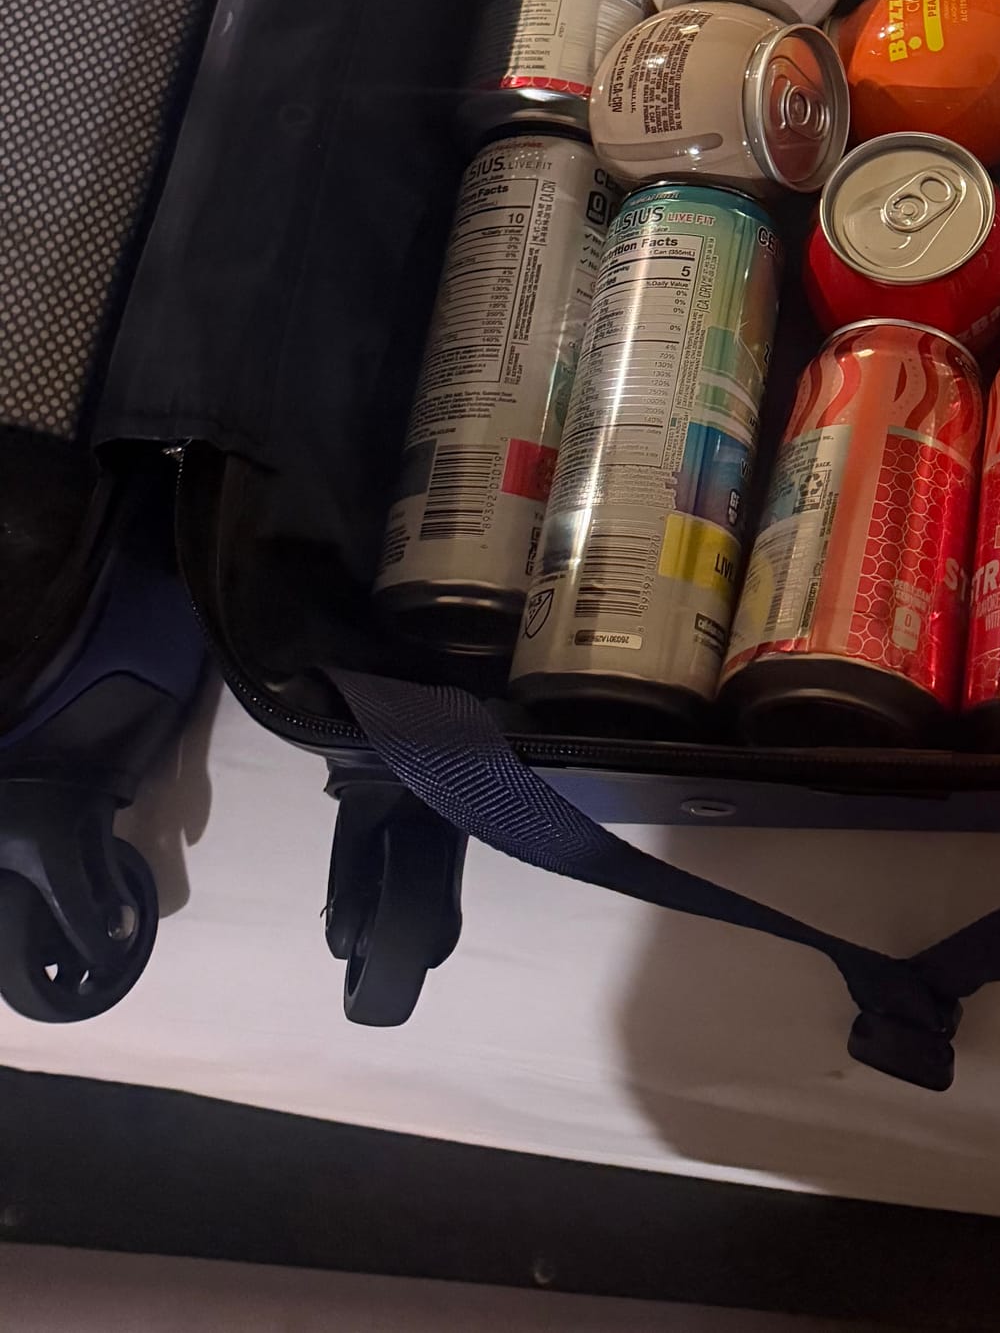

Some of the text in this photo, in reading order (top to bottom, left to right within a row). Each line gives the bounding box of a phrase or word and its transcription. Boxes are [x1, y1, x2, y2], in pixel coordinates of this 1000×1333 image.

[508, 212, 525, 225] 10
[667, 212, 694, 223] LIVE
[696, 214, 716, 226] FIT
[641, 236, 679, 249] Facts
[680, 265, 692, 278] 5
